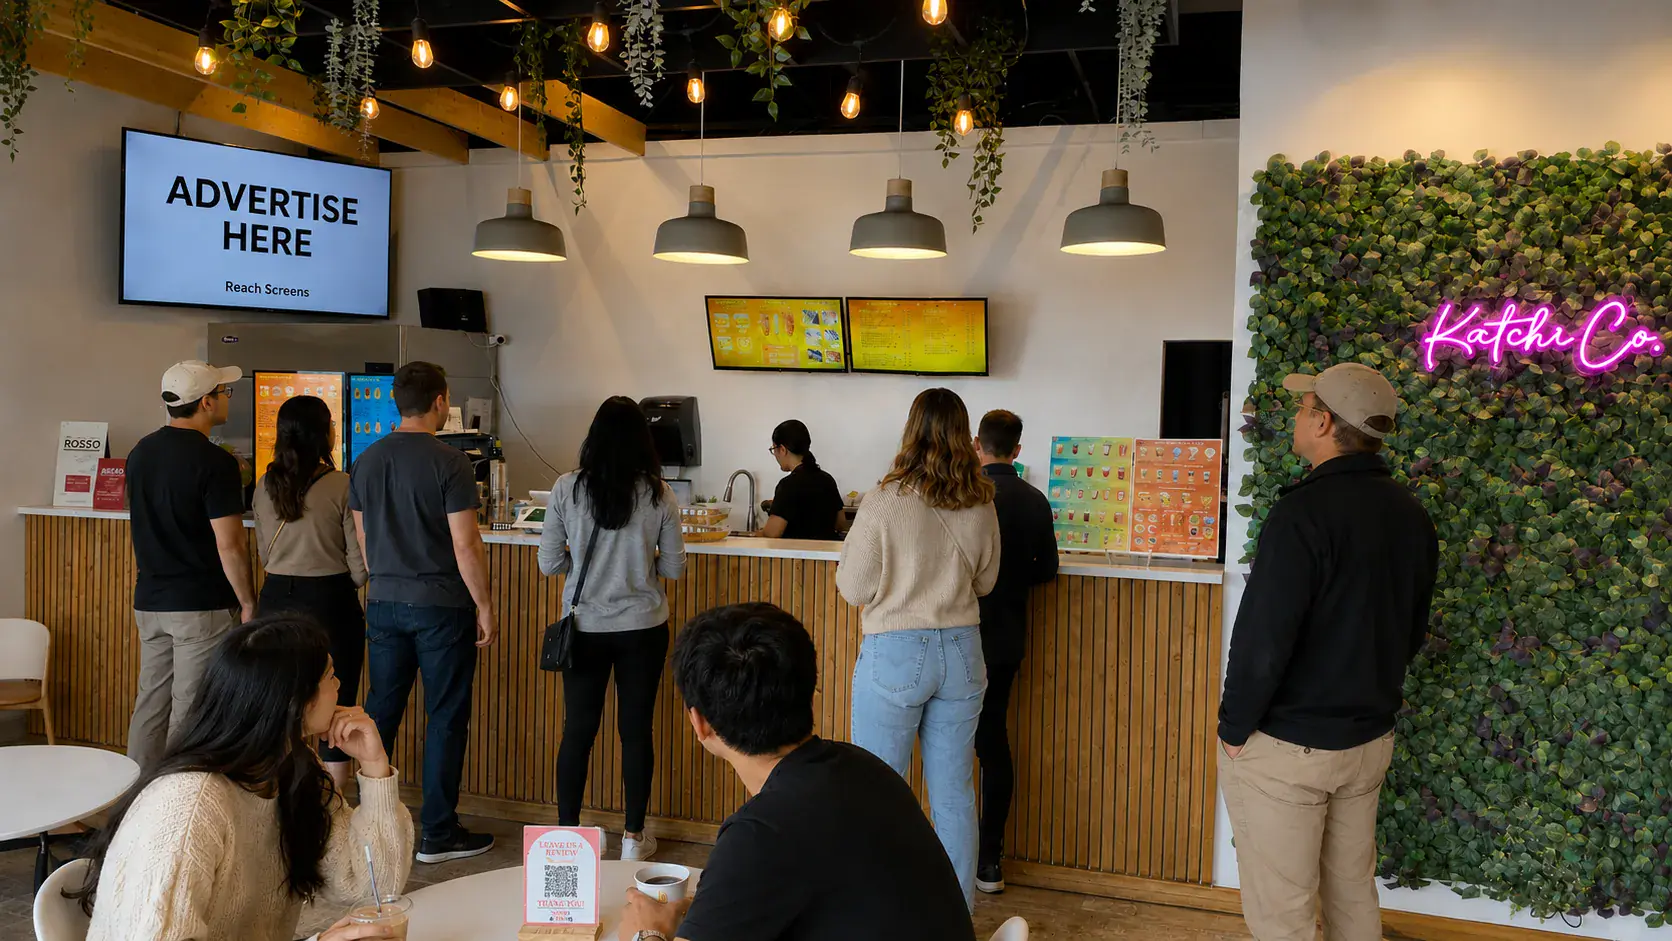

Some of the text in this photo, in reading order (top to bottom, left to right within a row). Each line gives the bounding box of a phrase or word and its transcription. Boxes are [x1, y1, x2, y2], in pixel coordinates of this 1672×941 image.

[166, 175, 358, 225] ADVERTISE
[223, 221, 312, 257] HERE
[225, 281, 310, 298] Reach Screens
[64, 439, 101, 449] ROSSO
